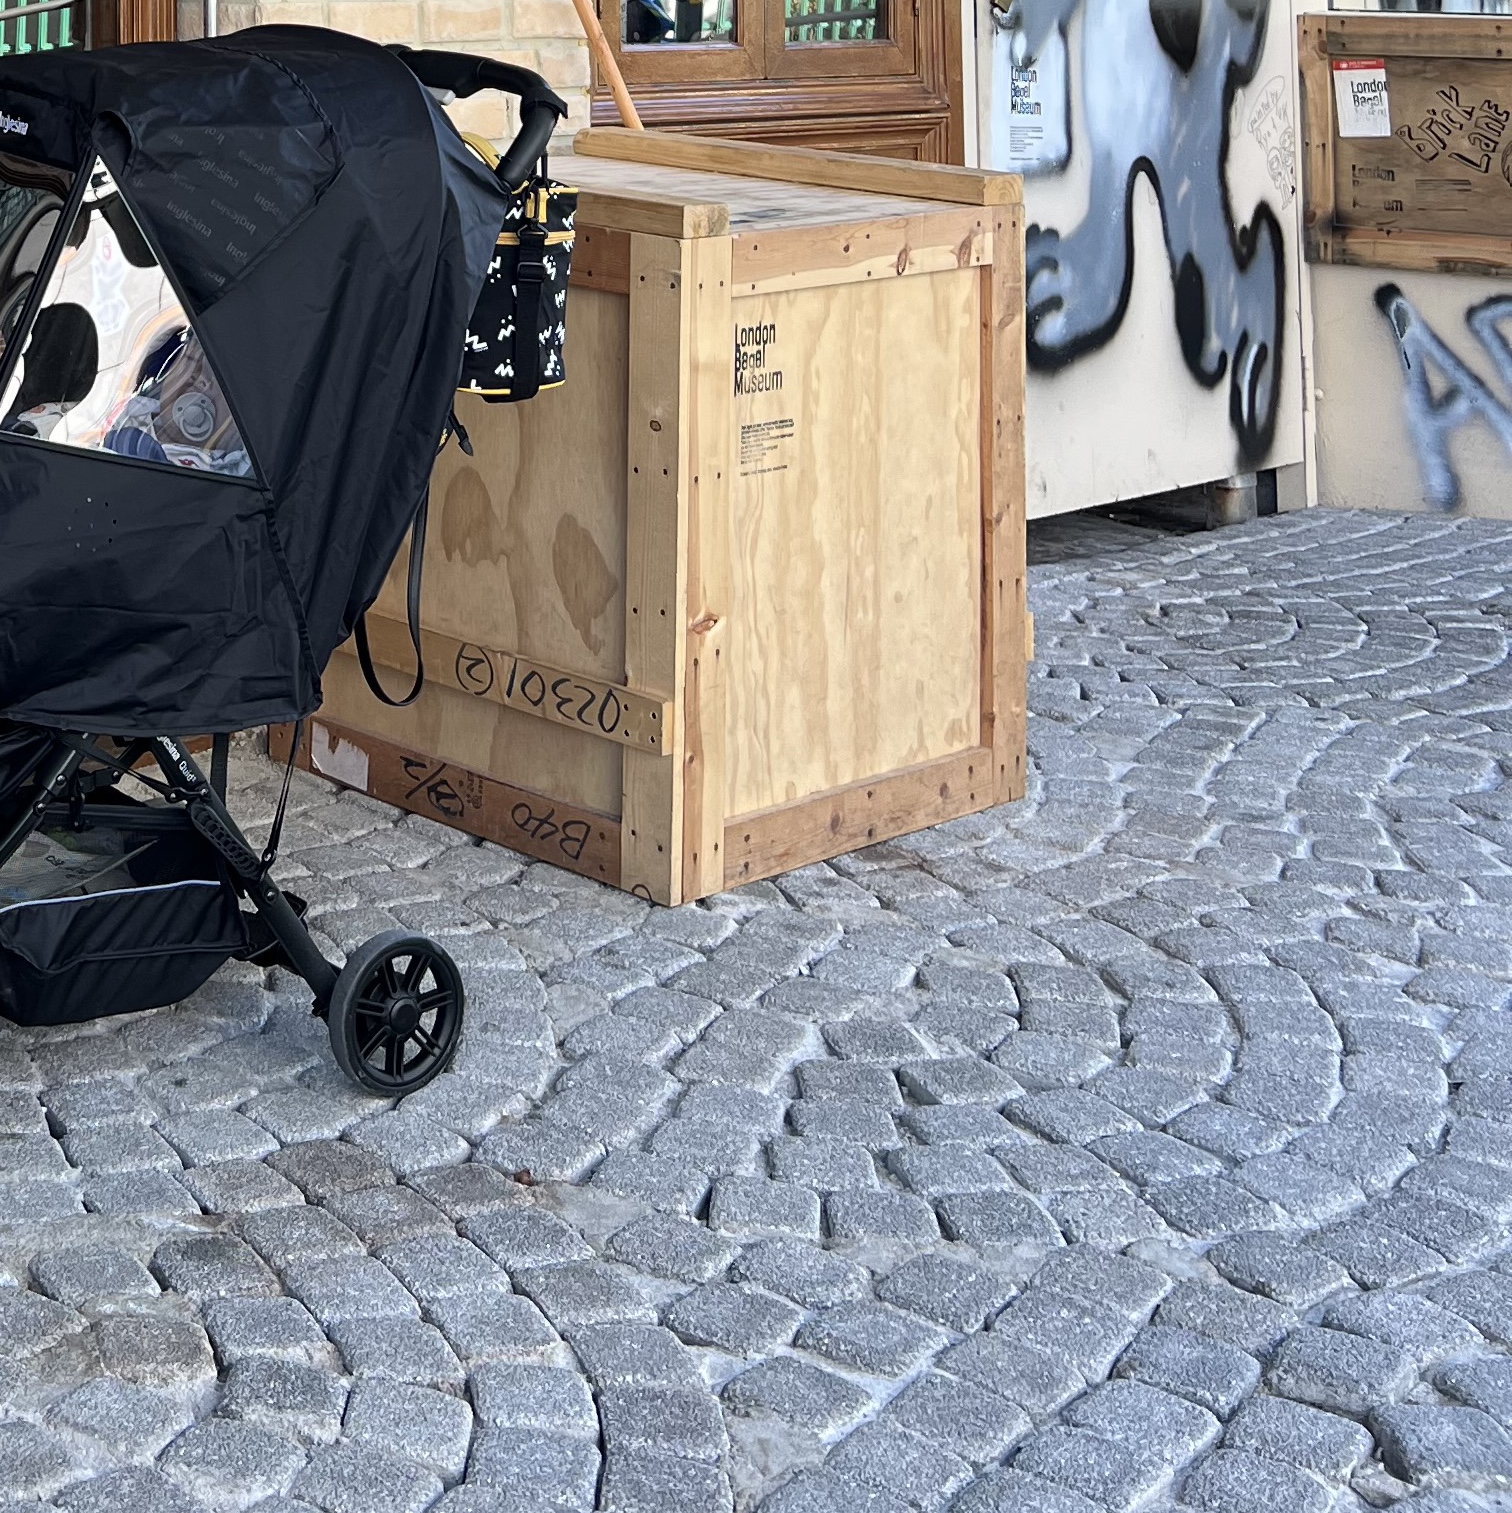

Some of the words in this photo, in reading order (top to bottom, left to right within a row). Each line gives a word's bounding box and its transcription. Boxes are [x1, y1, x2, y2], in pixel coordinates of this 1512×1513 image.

[1010, 65, 1038, 84] London
[734, 320, 777, 348] London
[733, 370, 783, 398] Museum
